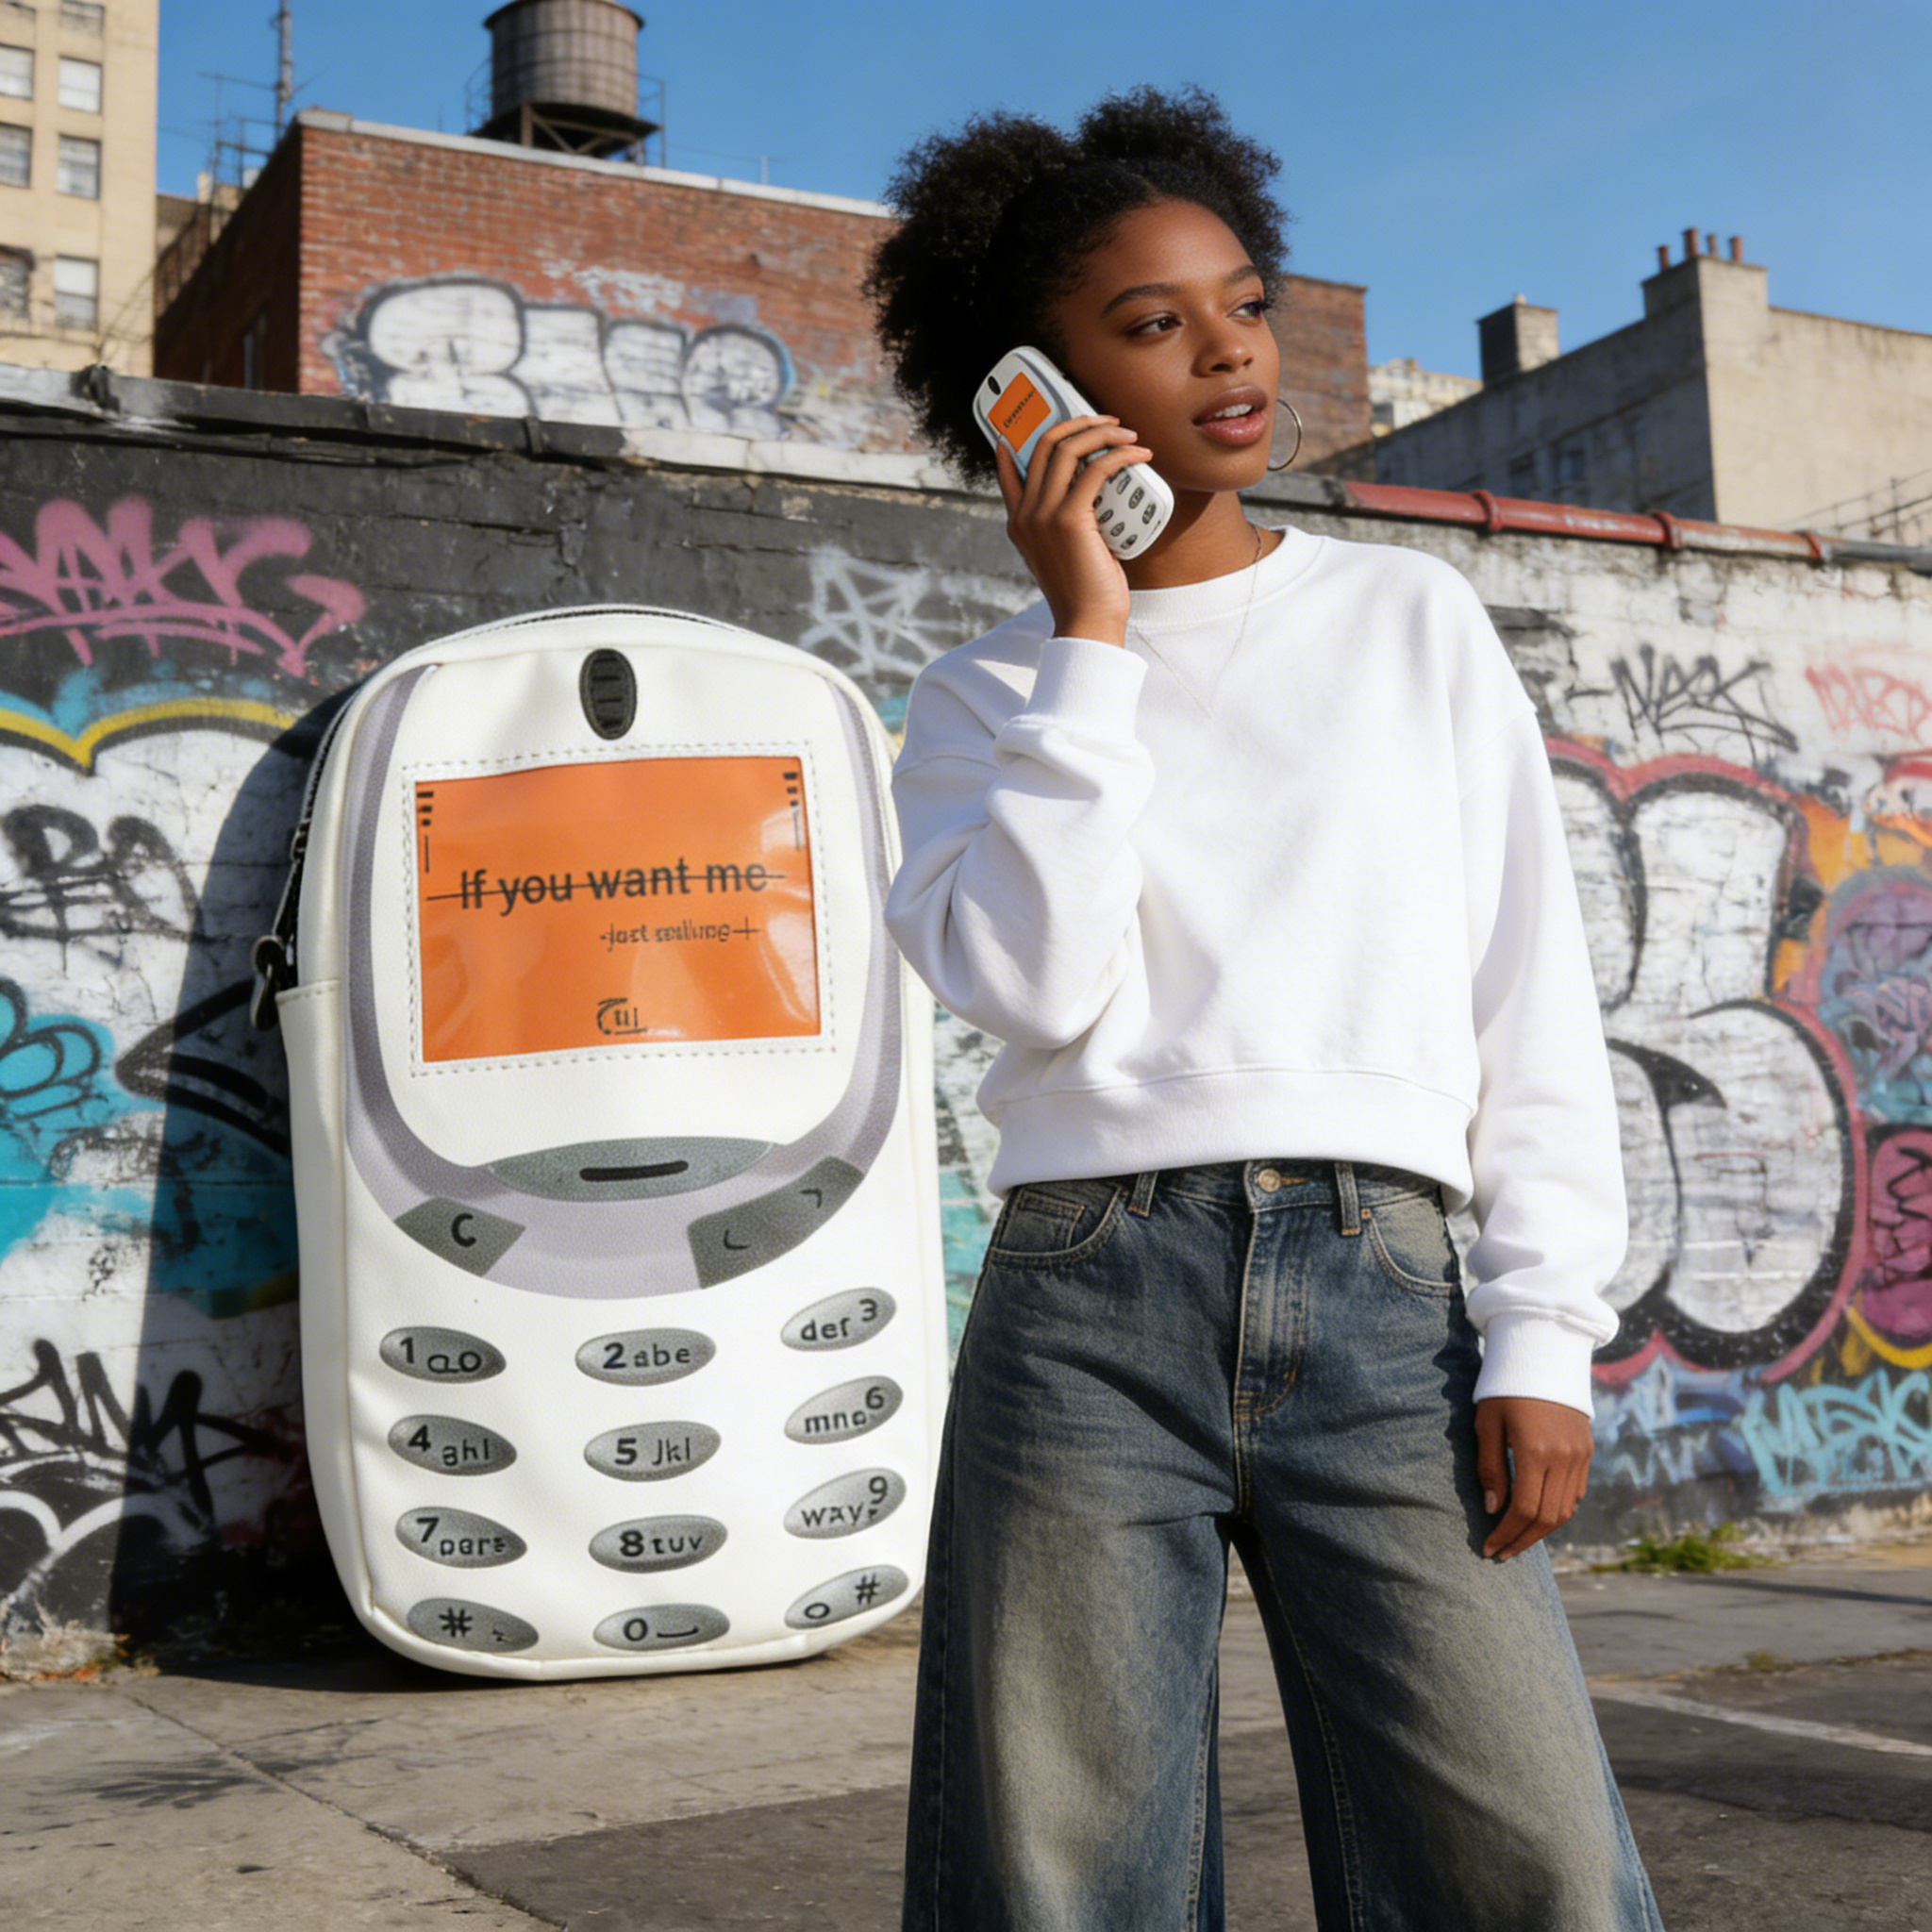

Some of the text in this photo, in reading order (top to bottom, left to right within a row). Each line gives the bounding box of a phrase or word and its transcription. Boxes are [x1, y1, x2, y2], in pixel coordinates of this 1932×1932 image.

[460, 858, 768, 917] If you want me
[400, 1337, 414, 1364] 1
[408, 1424, 431, 1452] 4
[614, 1438, 638, 1466] 5
[416, 1517, 439, 1543] 7
[619, 1529, 644, 1557] 8
